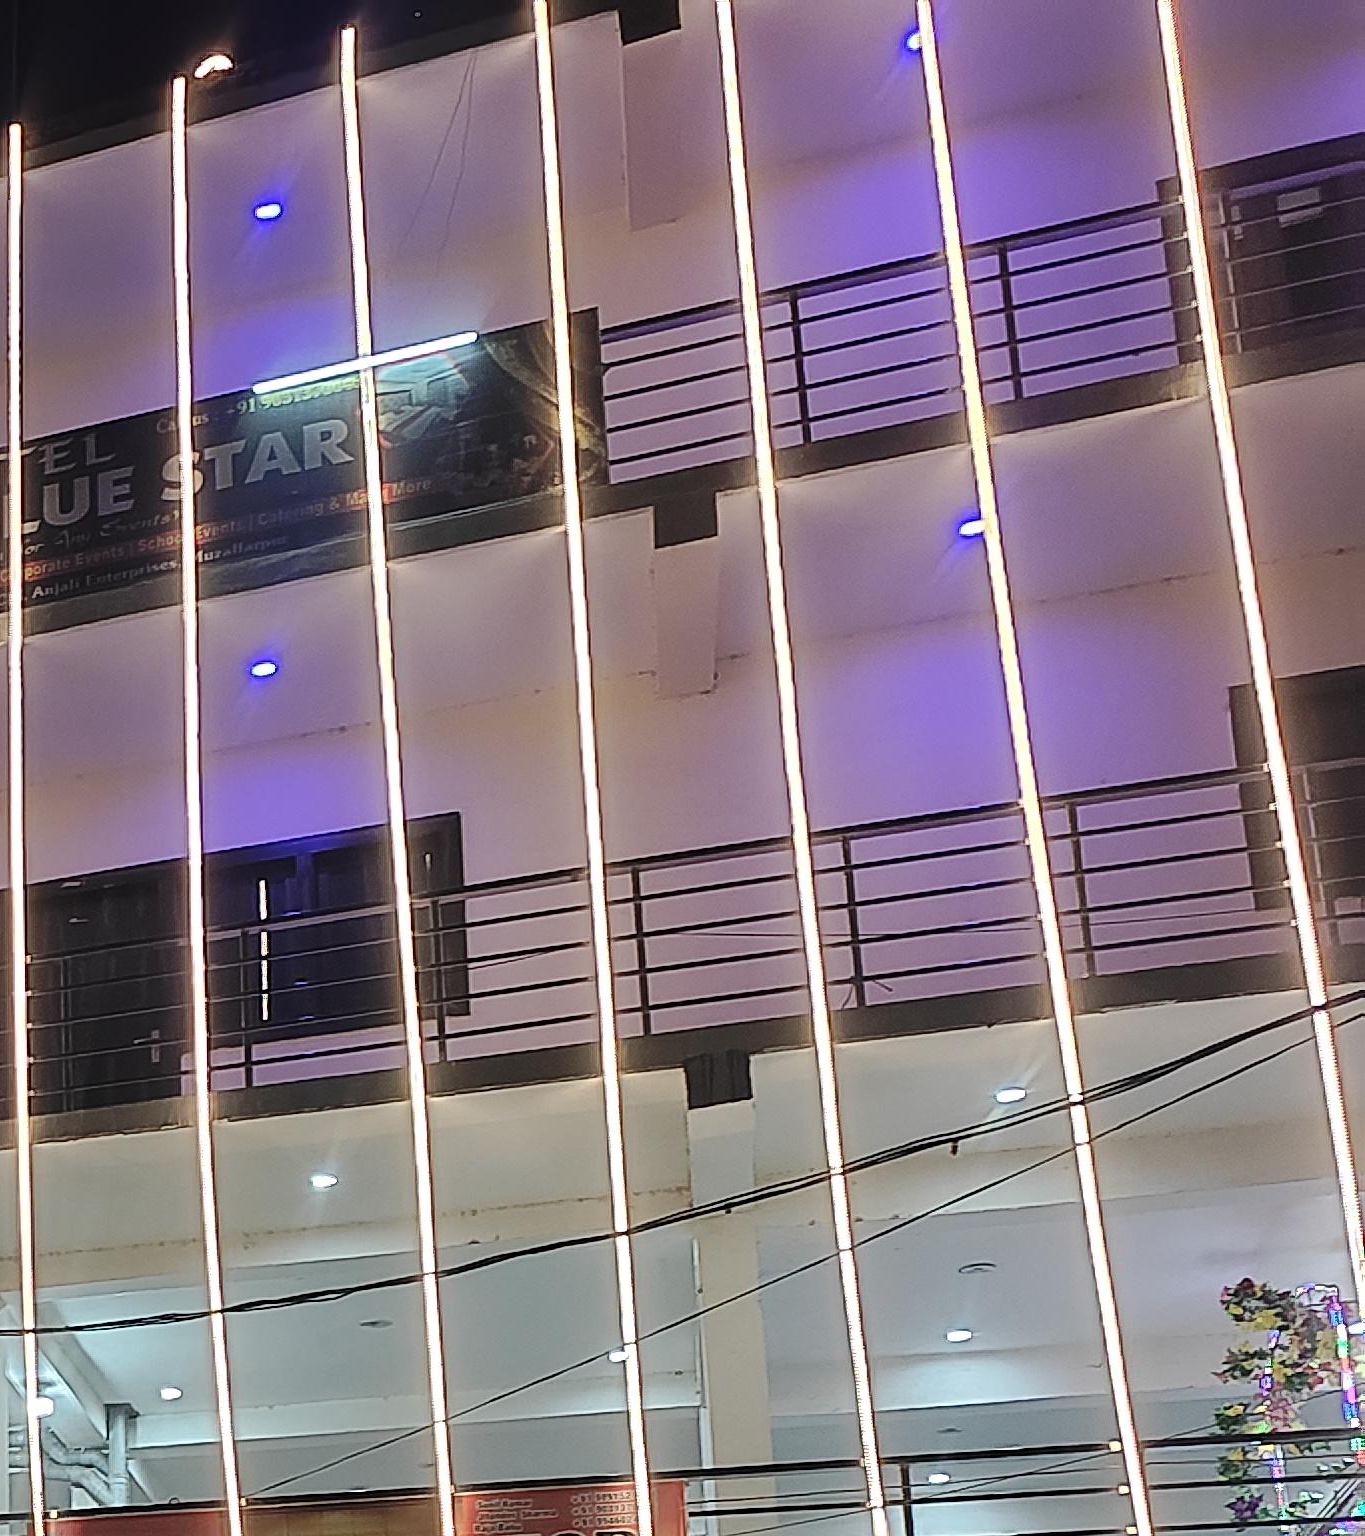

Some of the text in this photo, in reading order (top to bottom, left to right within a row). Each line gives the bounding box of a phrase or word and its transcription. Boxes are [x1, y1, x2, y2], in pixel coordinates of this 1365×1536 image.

[159, 418, 355, 501] STAR
[0, 558, 71, 585] Cporate
[75, 546, 126, 566] Events
[138, 530, 185, 550] Schoo
[195, 519, 246, 540] Events
[256, 502, 324, 527] Catering
[392, 478, 432, 498] More
[31, 579, 81, 601] Anjali
